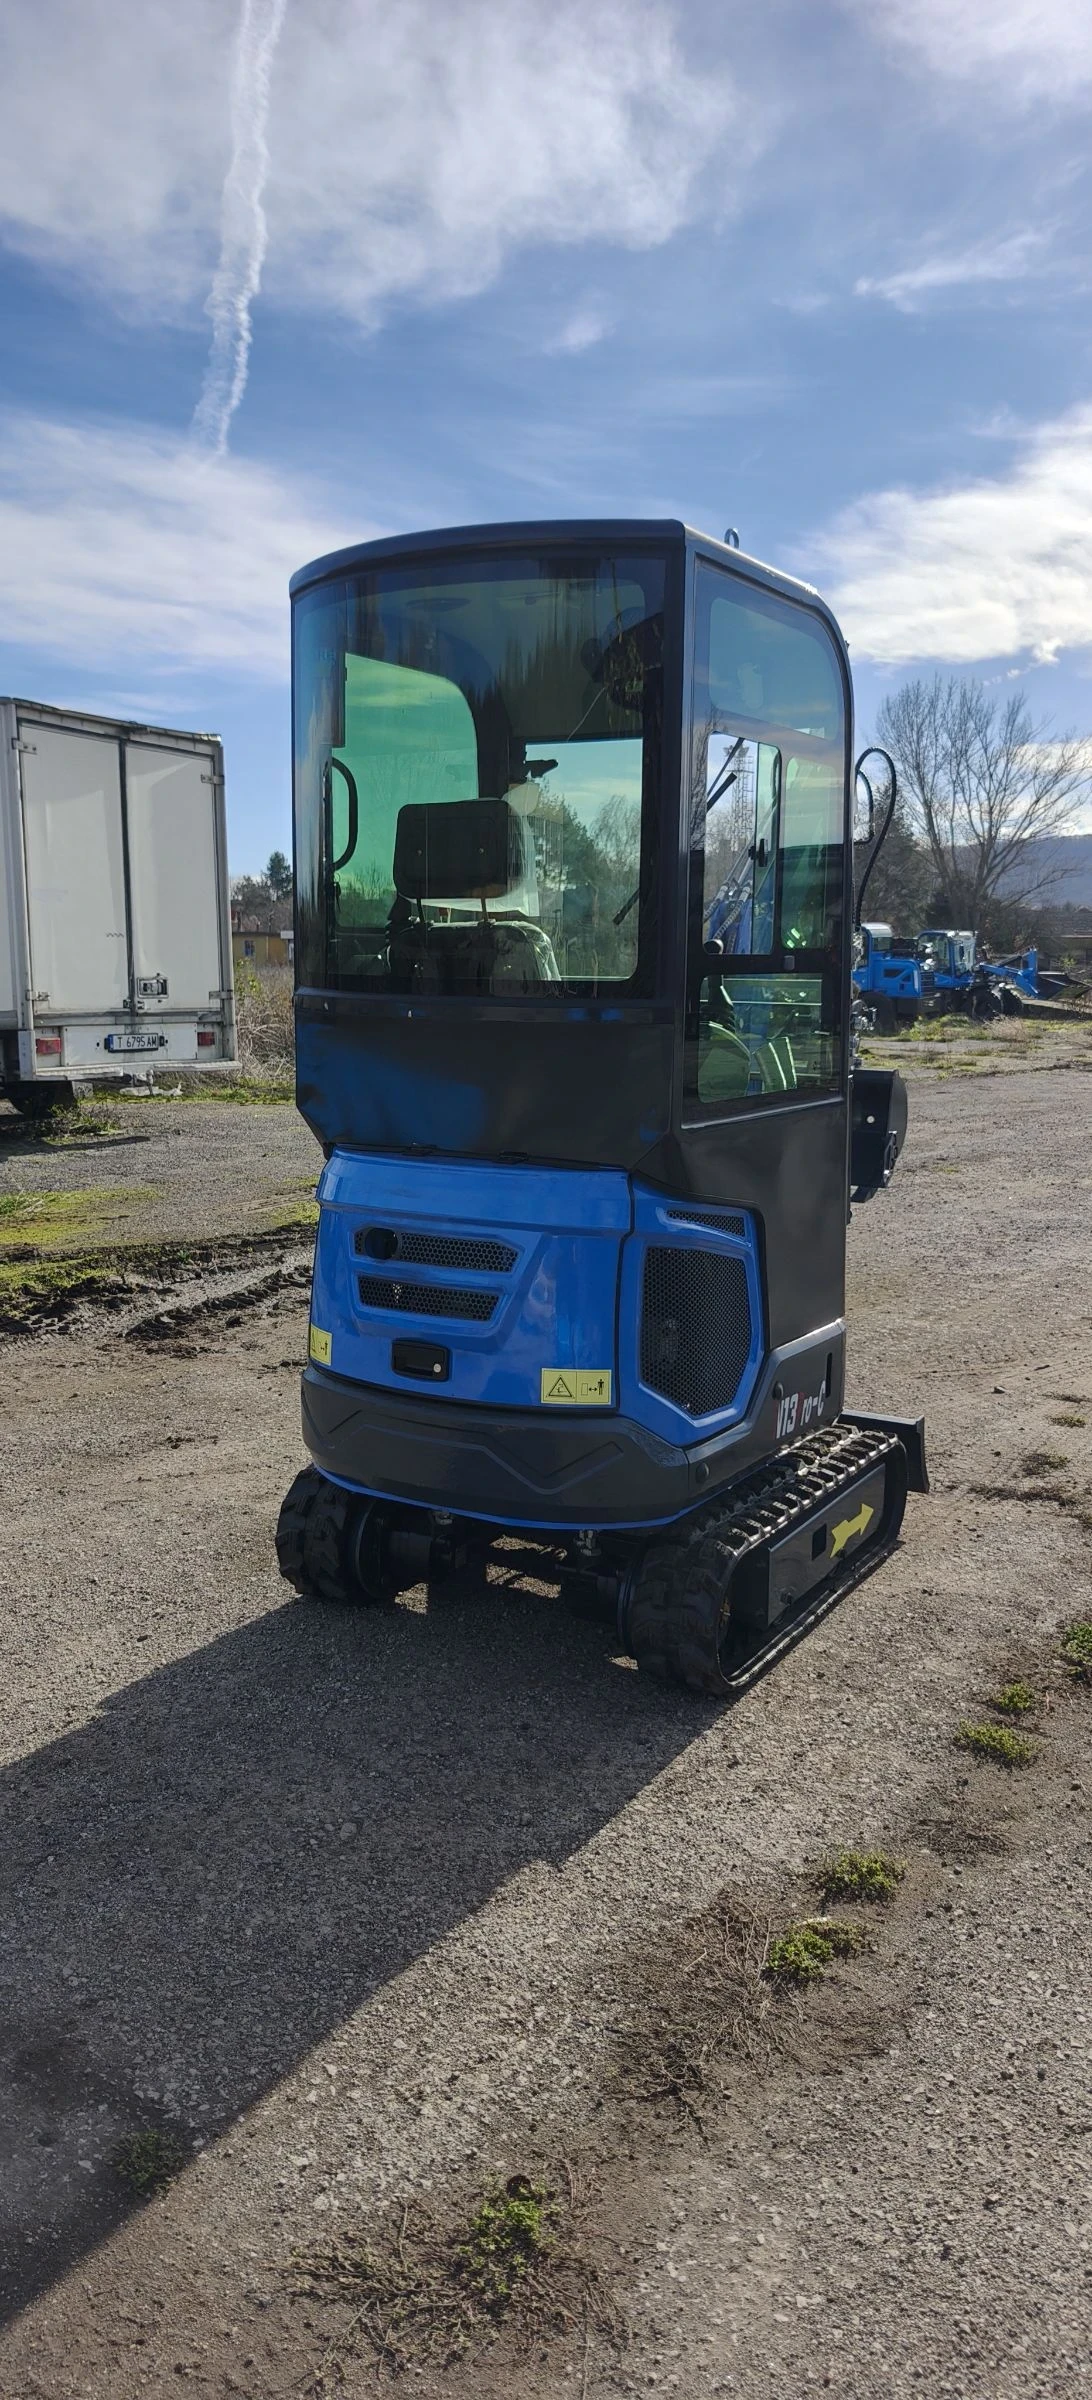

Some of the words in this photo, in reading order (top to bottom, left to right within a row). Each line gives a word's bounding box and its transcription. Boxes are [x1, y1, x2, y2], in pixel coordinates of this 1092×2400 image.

[117, 1037, 122, 1048] T
[126, 1036, 145, 1048] 6795
[147, 1036, 157, 1047] AM
